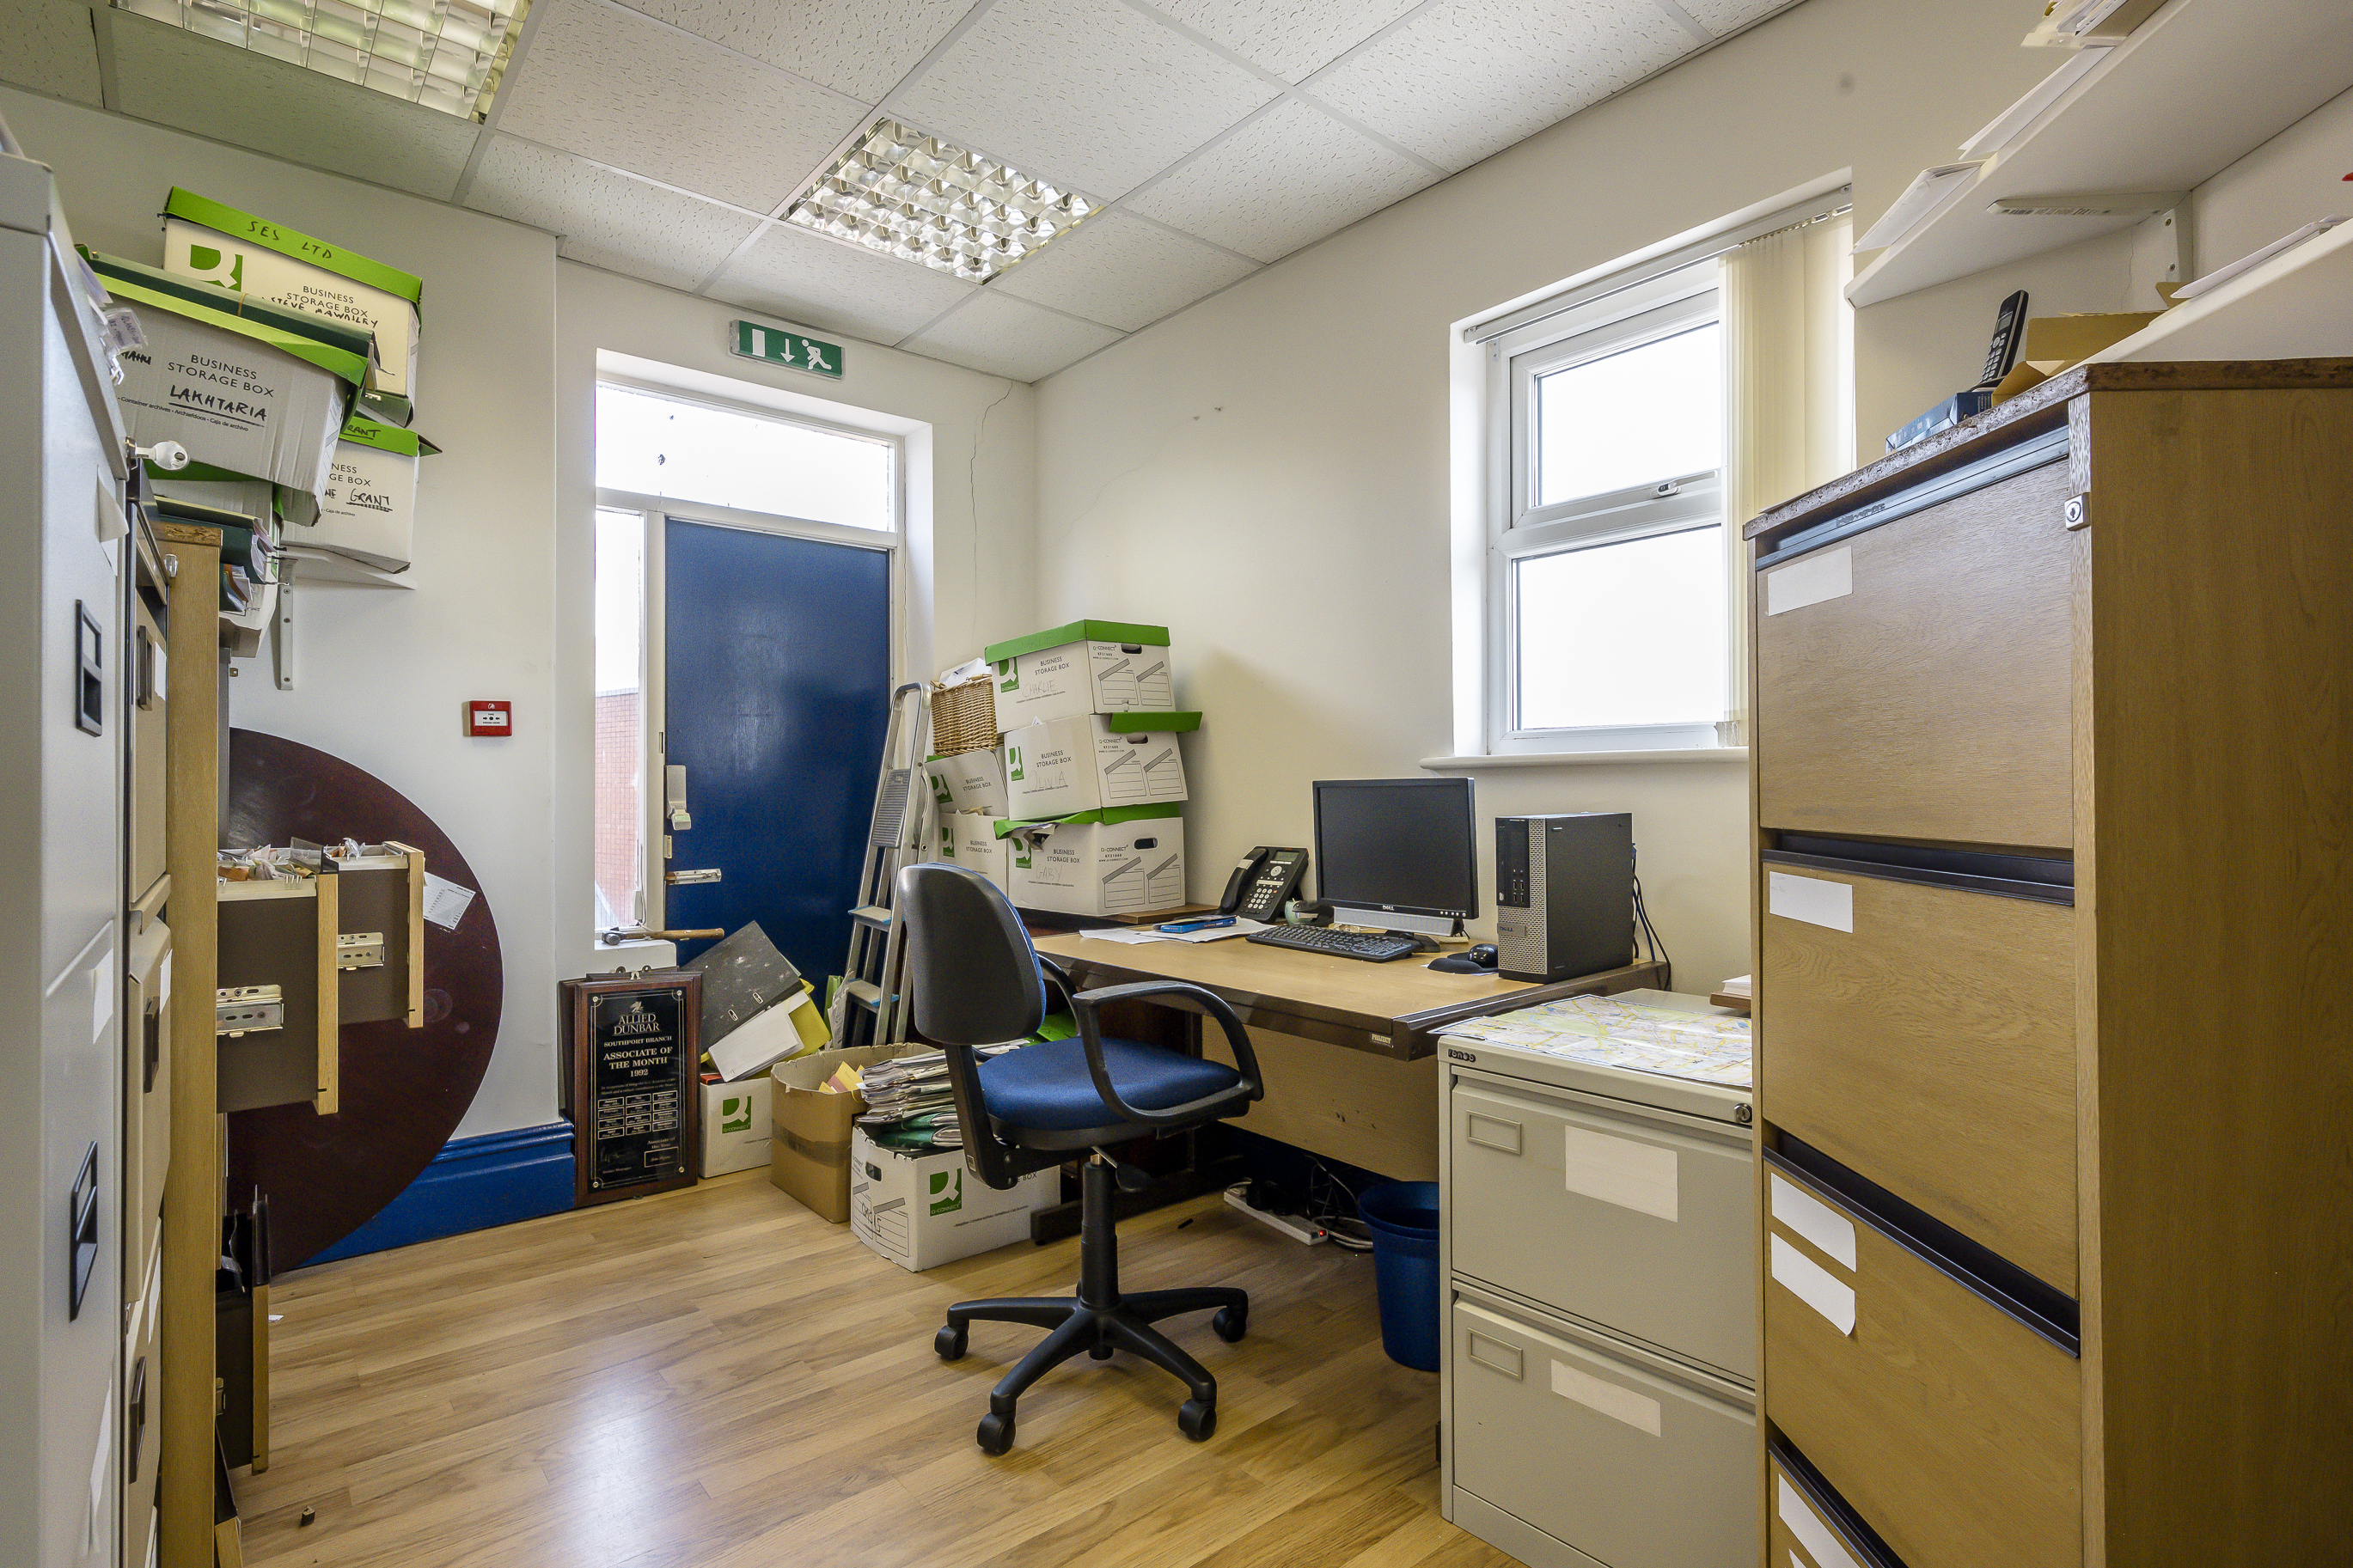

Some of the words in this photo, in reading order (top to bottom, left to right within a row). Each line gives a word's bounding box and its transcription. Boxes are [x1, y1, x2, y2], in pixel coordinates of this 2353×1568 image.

[247, 221, 279, 241] SES
[302, 242, 333, 259] LTD
[303, 285, 354, 304] BUSINESS
[286, 292, 339, 311] STORAGE
[344, 306, 368, 318] BOX
[191, 354, 257, 380] BUSINESS
[168, 362, 238, 387] STORAGE
[243, 381, 274, 398] BOX
[170, 385, 267, 422] LAKHTARIA
[121, 397, 148, 407] Container
[149, 404, 170, 412] archives
[174, 409, 206, 422] Archiefdoos
[229, 423, 249, 431] archivo
[345, 424, 382, 438] RANT
[331, 463, 358, 474] NESS
[347, 476, 371, 487] BOX
[350, 488, 390, 507] GRANT
[1040, 656, 1062, 667] BUSINESS
[1035, 666, 1058, 675] STORAGE
[1041, 750, 1063, 759] BUSINESS
[1036, 759, 1059, 767] STORAGE
[619, 1014, 657, 1025] ALLIED
[614, 1022, 660, 1035] DUNBAR
[604, 1039, 645, 1047] SOUTHPORT
[1372, 1034, 1390, 1044] PROJECT
[603, 1048, 657, 1061] ASSOCIATE
[609, 1061, 630, 1070] THE
[633, 1057, 668, 1067] MONTH
[630, 1069, 649, 1077] 1992
[931, 1204, 960, 1215] Q-CONNECT
